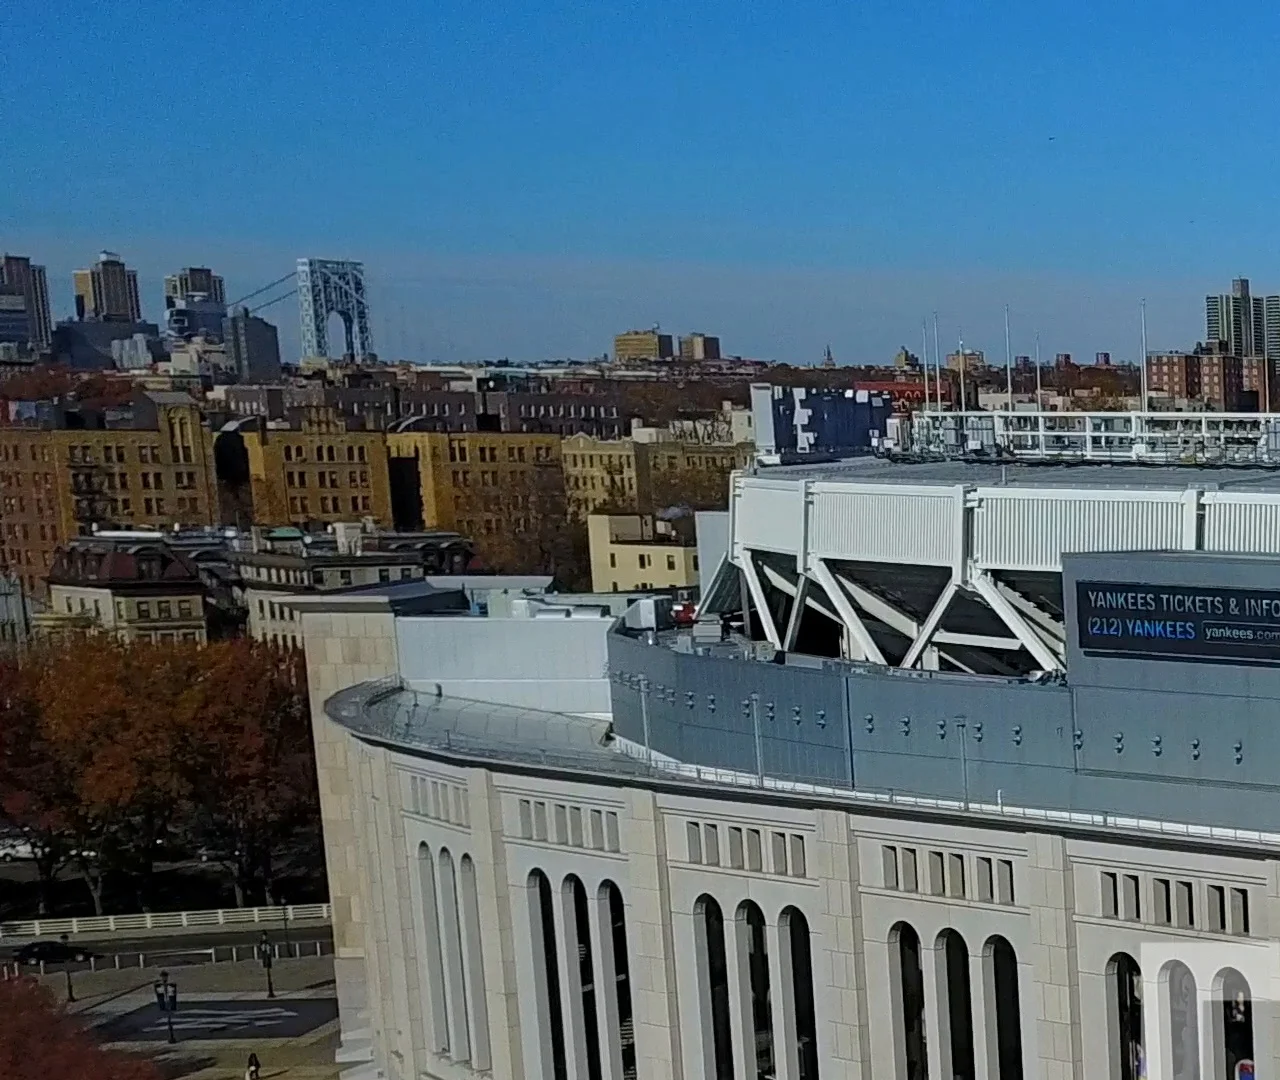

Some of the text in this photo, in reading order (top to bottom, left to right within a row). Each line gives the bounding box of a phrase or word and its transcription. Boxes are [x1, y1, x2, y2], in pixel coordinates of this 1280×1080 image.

[1087, 590, 1156, 611] YANKEES
[1160, 593, 1224, 614] TICKETS
[1228, 598, 1241, 615] &
[1087, 616, 1123, 637] (212)
[1126, 618, 1196, 639] YANKEES
